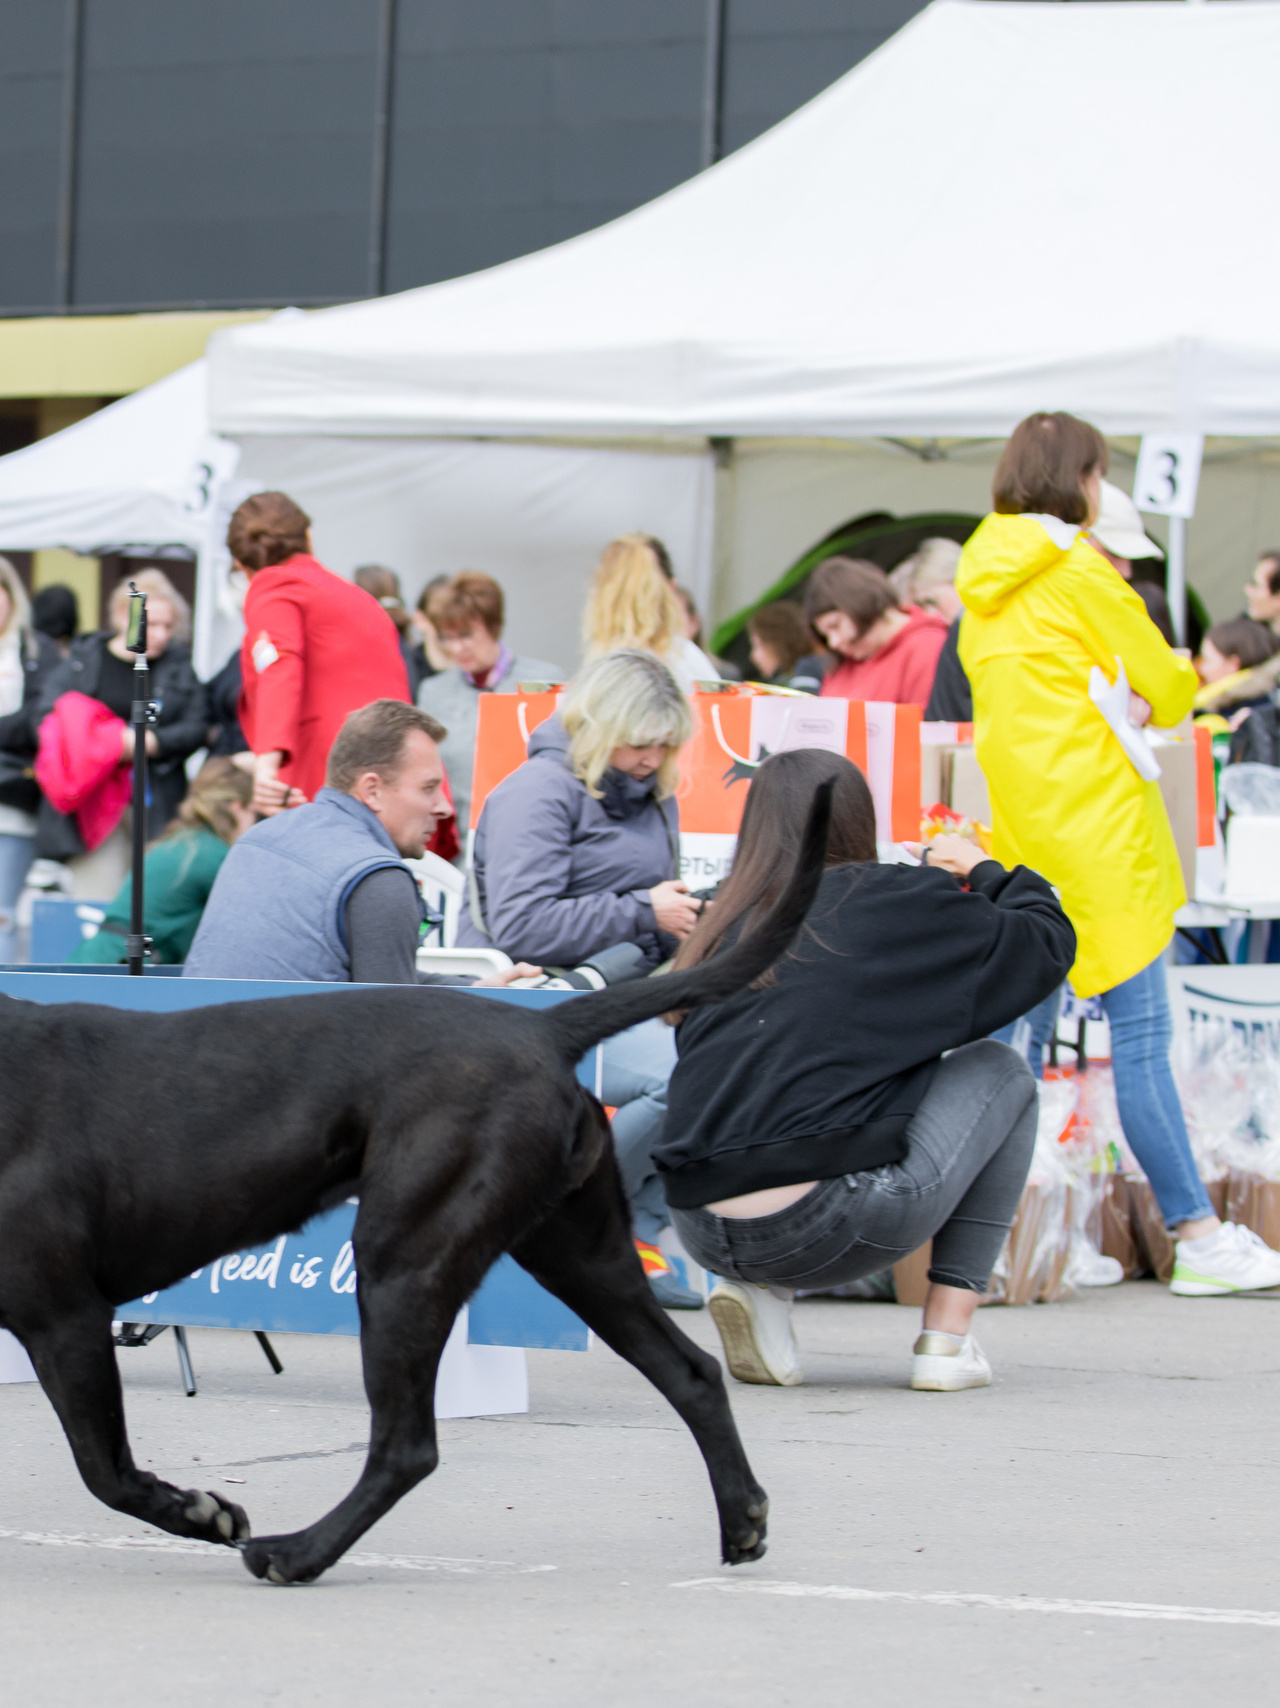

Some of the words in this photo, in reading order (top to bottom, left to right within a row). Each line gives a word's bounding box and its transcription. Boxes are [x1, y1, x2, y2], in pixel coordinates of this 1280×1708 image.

[184, 461, 213, 512] 3
[1146, 450, 1179, 505] 3
[289, 1253, 324, 1289] is
